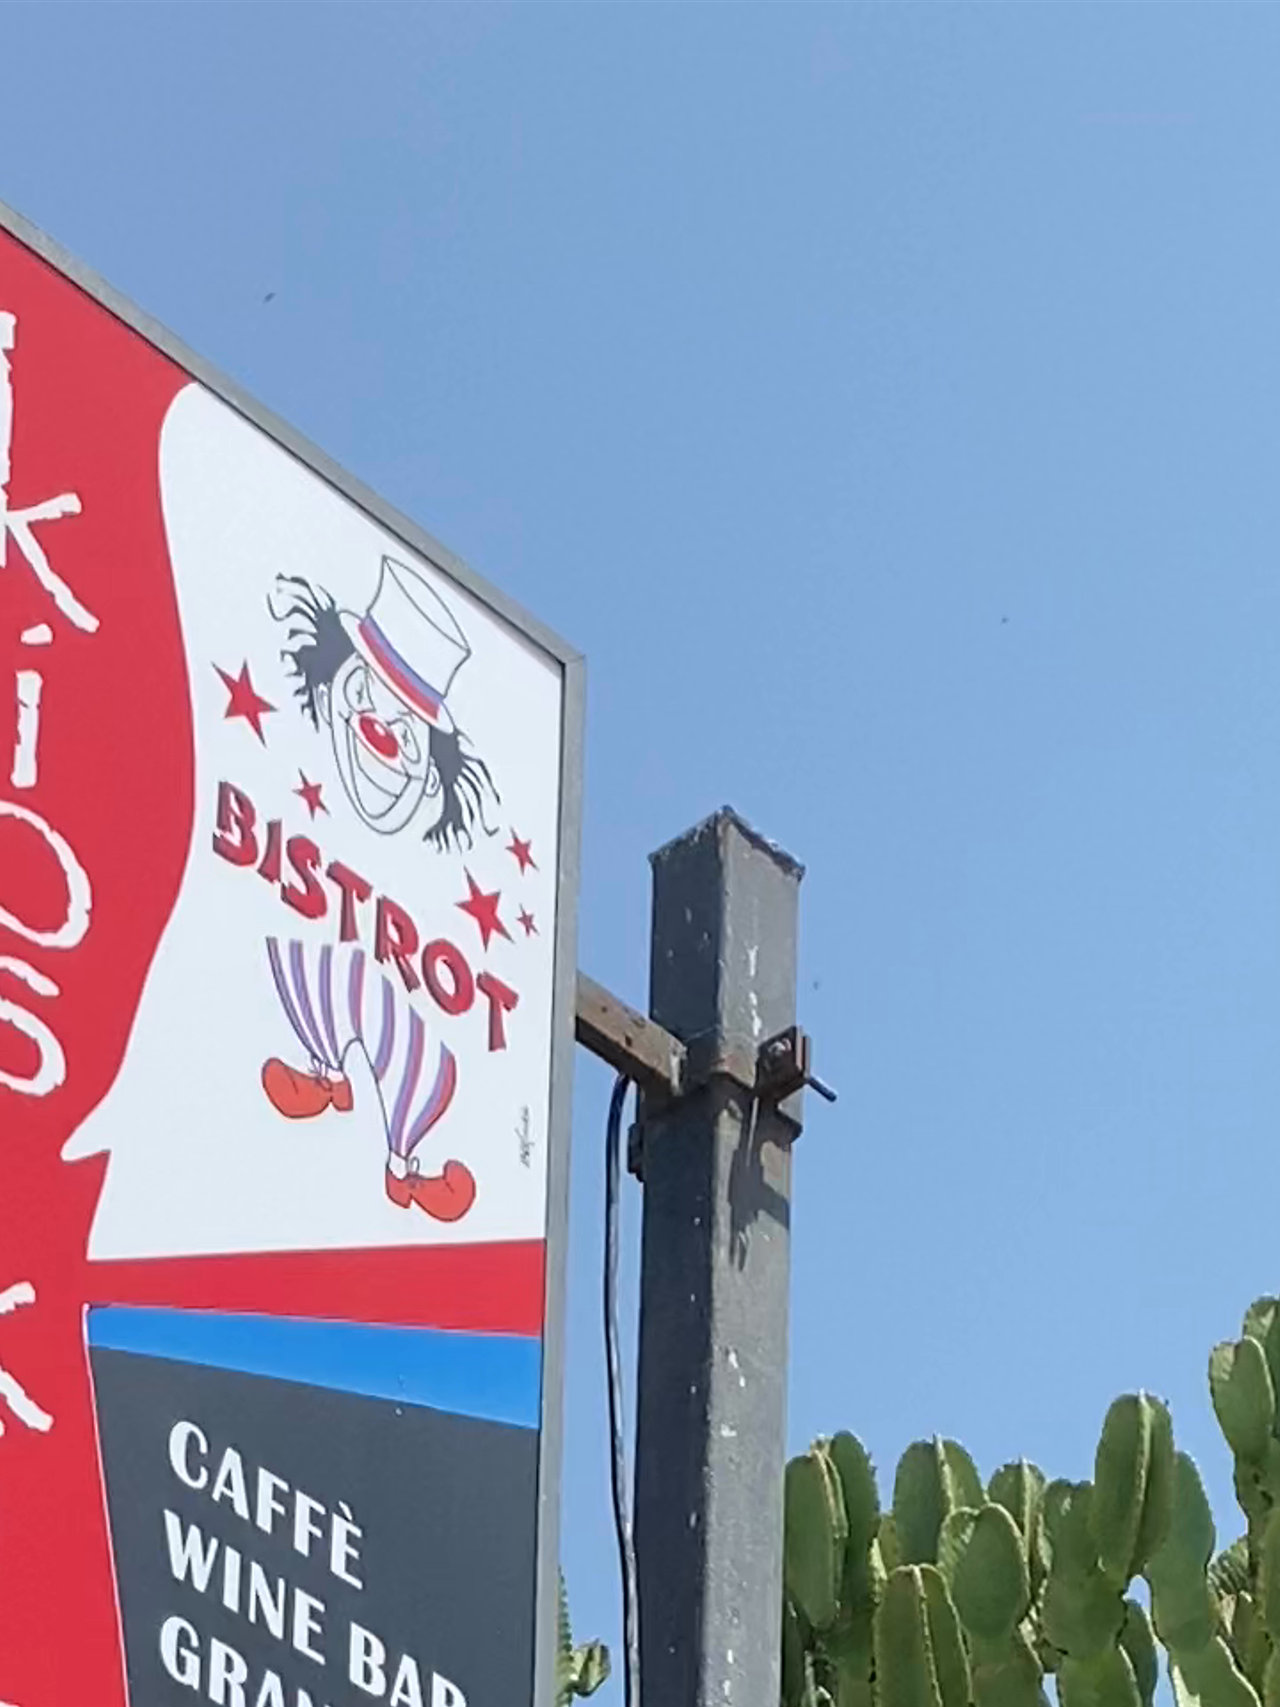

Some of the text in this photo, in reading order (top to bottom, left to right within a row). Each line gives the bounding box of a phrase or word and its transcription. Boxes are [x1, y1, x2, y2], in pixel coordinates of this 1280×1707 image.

[213, 781, 519, 1051] BISTROT
[163, 1508, 326, 1666] WINE
[168, 1420, 363, 1589] CAFFÈ
